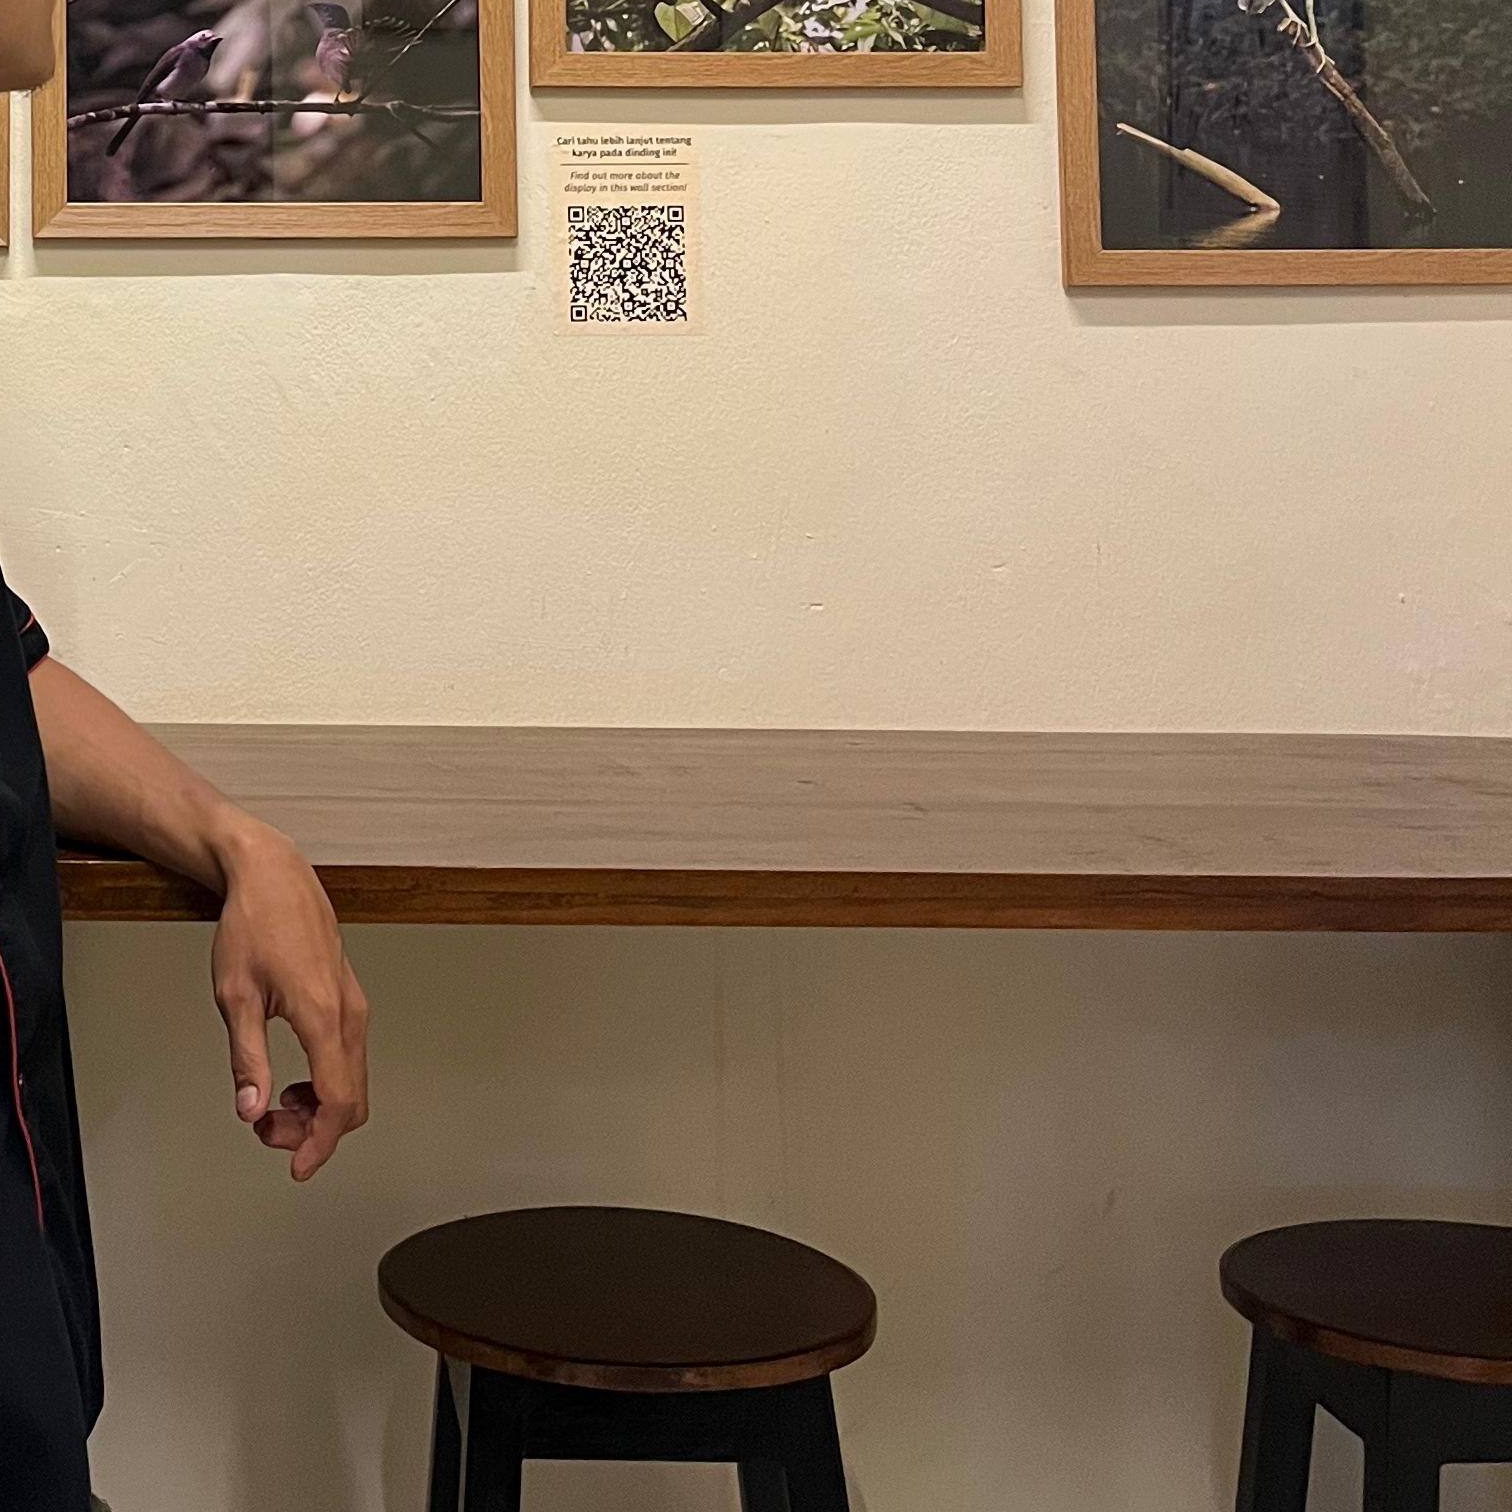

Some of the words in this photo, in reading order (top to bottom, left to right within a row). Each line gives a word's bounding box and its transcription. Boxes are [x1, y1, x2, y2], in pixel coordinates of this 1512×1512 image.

[556, 137, 575, 145] Cari
[577, 137, 598, 145] tahu
[600, 136, 624, 145] lebih
[626, 136, 653, 146] lanjut
[656, 137, 691, 146] tentang
[572, 149, 597, 158] karya
[600, 149, 623, 158] pada
[625, 148, 660, 158] dinding
[570, 171, 589, 180] Find
[592, 172, 607, 180] out
[636, 171, 662, 180] about
[665, 171, 680, 180] the
[564, 184, 596, 194] display
[600, 184, 608, 192] in
[611, 184, 628, 192] this
[630, 184, 649, 192] wall
[651, 183, 687, 192] section!
